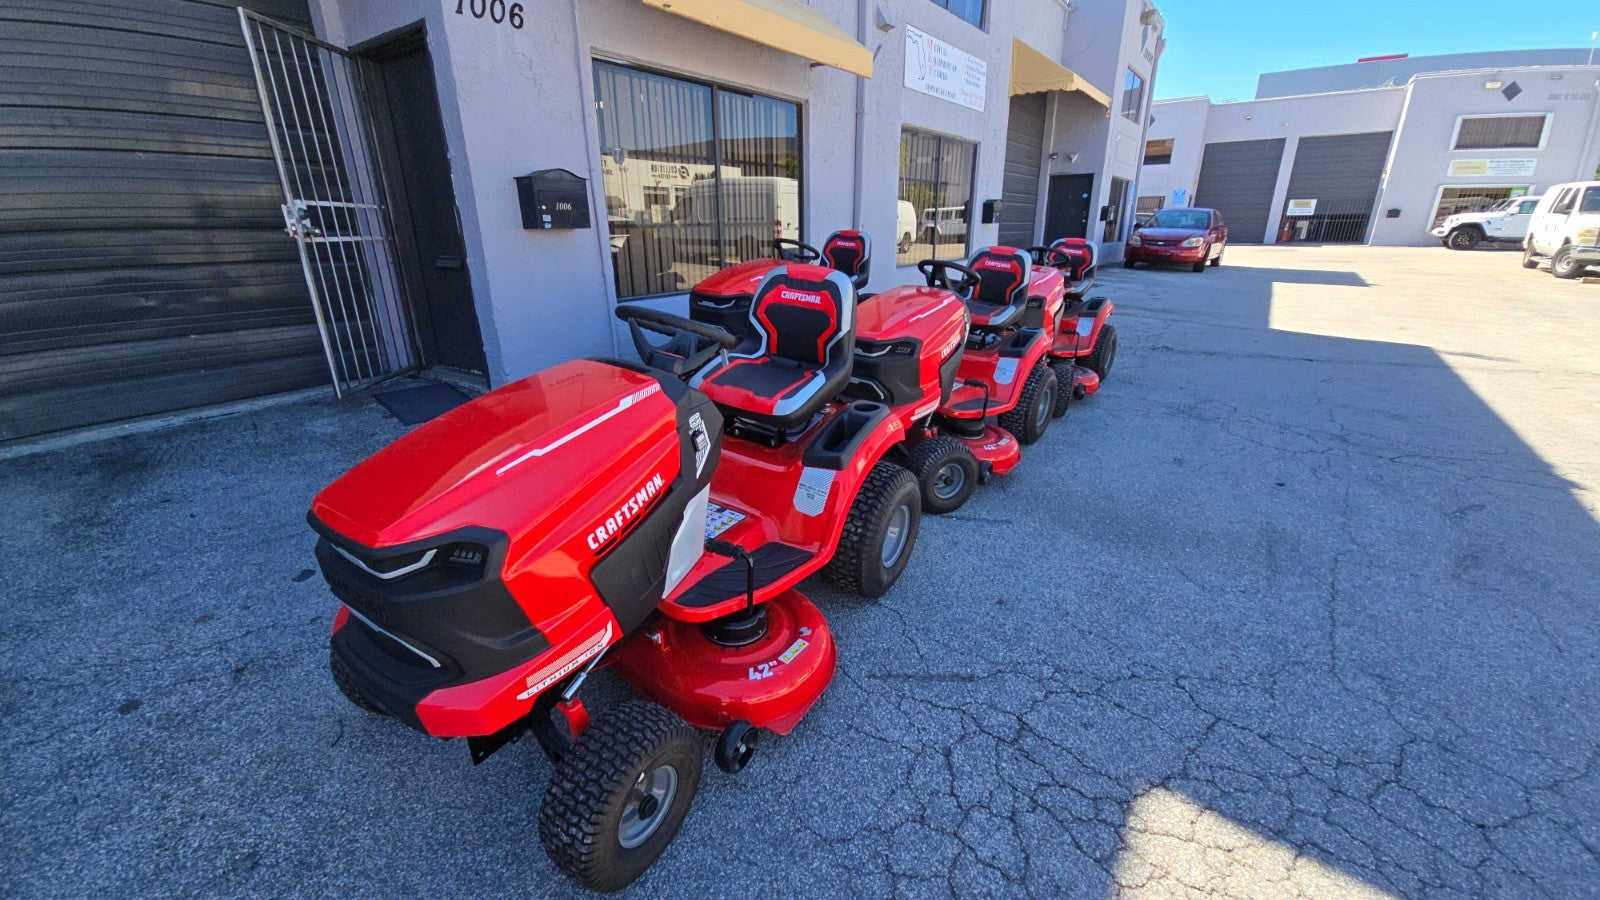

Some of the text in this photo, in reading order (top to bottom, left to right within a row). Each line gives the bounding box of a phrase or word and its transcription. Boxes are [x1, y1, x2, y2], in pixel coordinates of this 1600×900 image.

[455, 0, 524, 29] 1006
[556, 202, 572, 211] 1006
[781, 290, 821, 304] CRAFTSMAN
[587, 473, 664, 550] CRAFTSMAN
[526, 643, 604, 697] LITHIUM ION
[748, 660, 778, 680] 42"
